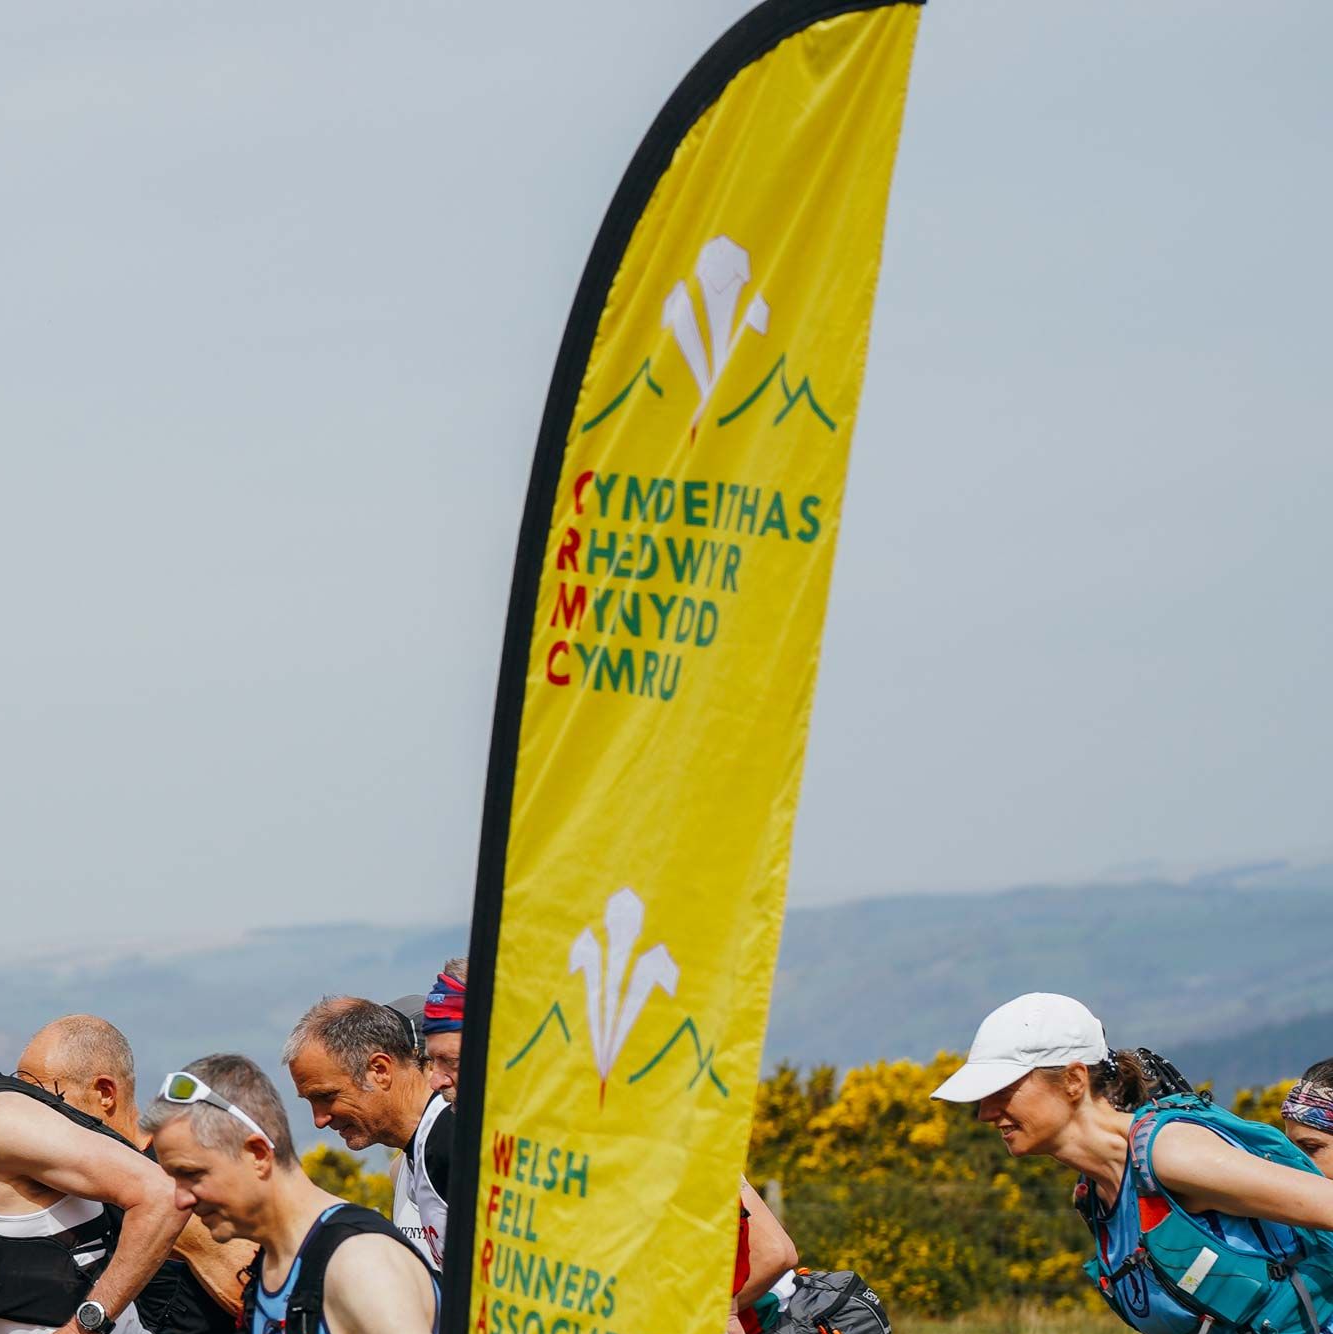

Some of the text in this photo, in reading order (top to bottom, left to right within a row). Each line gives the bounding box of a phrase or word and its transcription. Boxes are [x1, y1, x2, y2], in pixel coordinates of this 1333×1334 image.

[556, 528, 742, 593] RHEDWYR
[550, 582, 719, 647] MYNYDD
[546, 641, 683, 702] CYMRU
[492, 1130, 589, 1199] WELSH
[487, 1185, 539, 1243] FELL
[480, 1238, 617, 1319] RUNNERS
